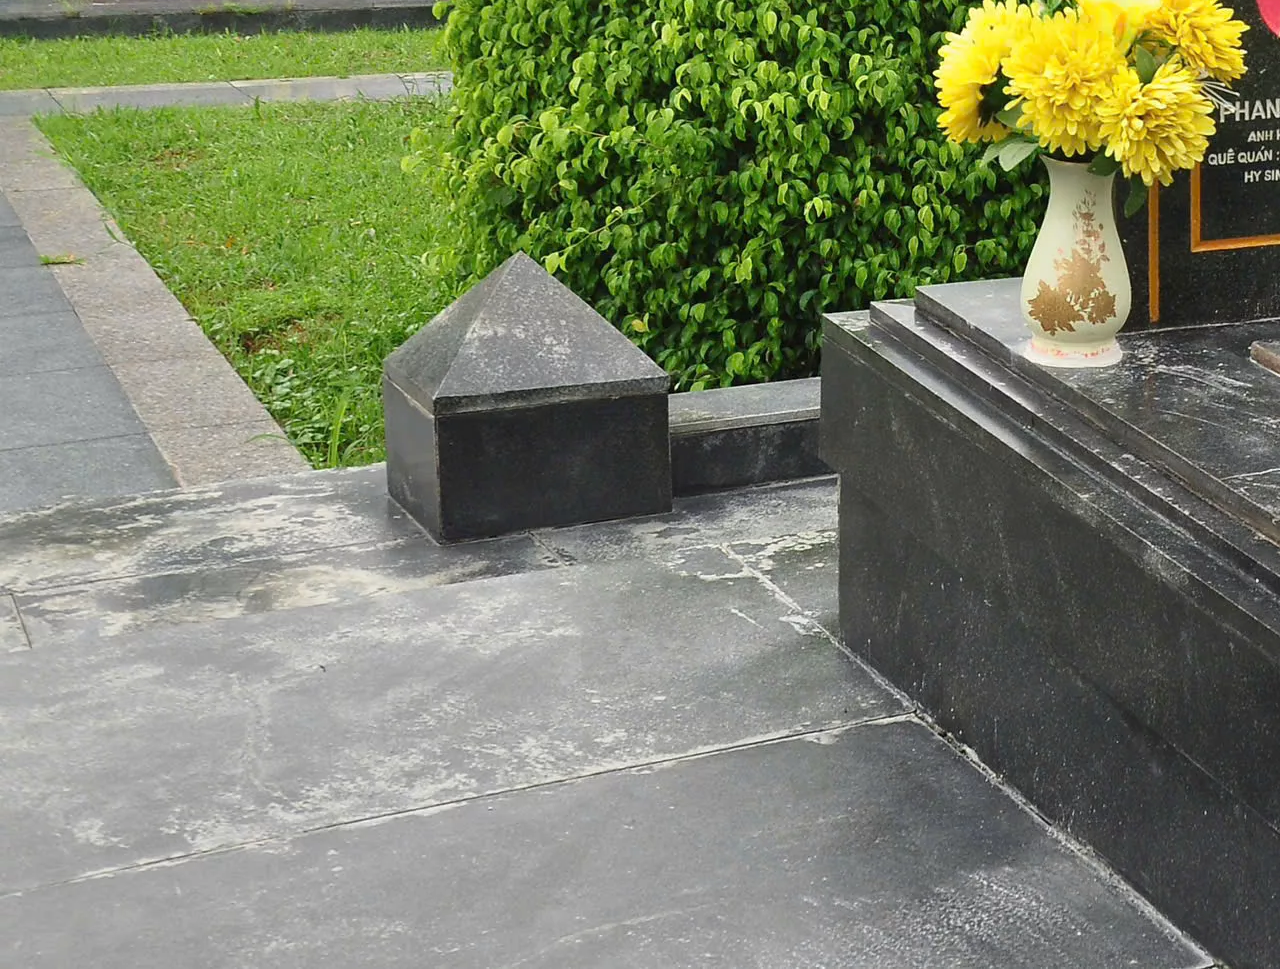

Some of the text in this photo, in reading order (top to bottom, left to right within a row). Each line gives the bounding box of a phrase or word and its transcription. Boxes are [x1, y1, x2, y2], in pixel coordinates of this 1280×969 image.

[1220, 98, 1280, 123] PHAN
[1247, 130, 1273, 142] ANH
[1208, 148, 1234, 165] QUÊ
[1238, 146, 1272, 163] QUÁN
[1244, 172, 1261, 183] HY
